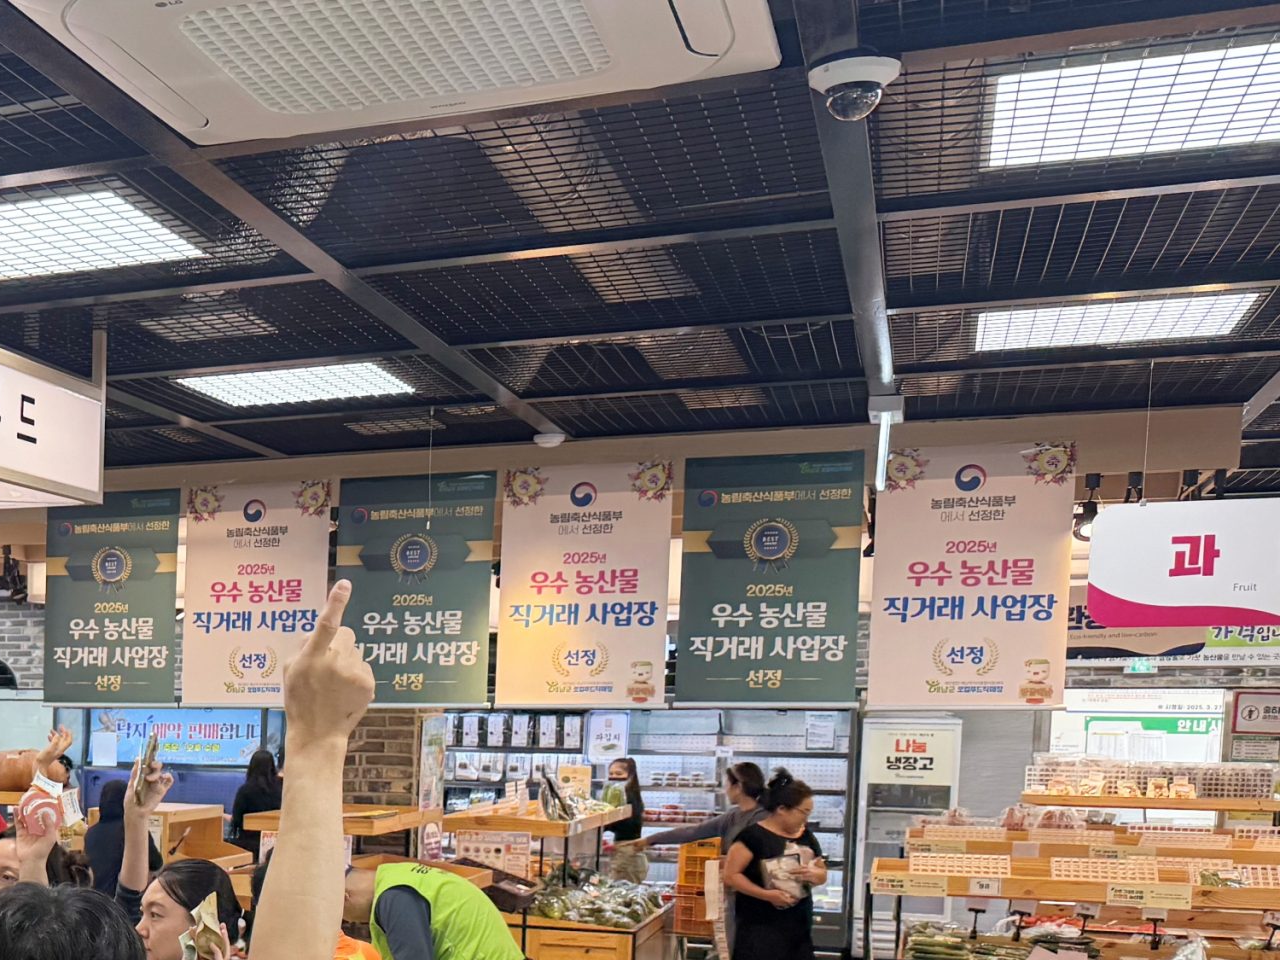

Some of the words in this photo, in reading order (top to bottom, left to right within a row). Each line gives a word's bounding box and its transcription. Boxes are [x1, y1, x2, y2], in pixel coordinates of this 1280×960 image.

[721, 490, 816, 503] 농림축산식품부에서
[819, 488, 852, 500] 선정한
[931, 495, 1016, 509] 농림축산식품부
[455, 505, 483, 517] 선정한
[549, 511, 623, 524] 농림축산식품부
[941, 510, 964, 522] 에서
[968, 509, 1005, 521] 선정한
[146, 520, 170, 531] 선정한
[226, 525, 289, 539] 농림축산식품부
[581, 523, 613, 535] 선정한
[253, 537, 280, 548] 선정한
[946, 541, 997, 554] 2025년
[563, 552, 606, 565] 2025년
[1169, 535, 1220, 577] 과
[237, 563, 275, 576] 2025년
[907, 561, 952, 587] 우수
[960, 559, 1034, 586] 농산물
[530, 572, 568, 594] 우수
[575, 569, 639, 594] 농산물
[1233, 583, 1257, 592] Fruit
[209, 582, 244, 604] 우수
[247, 579, 303, 604] 농산물
[746, 583, 793, 597] 2025년
[94, 602, 128, 614] 2025년
[392, 594, 433, 607] 2025년
[883, 596, 964, 622] 직거래
[971, 594, 1057, 622] 사업장
[192, 610, 252, 633] 직거래
[257, 608, 319, 633] 사업장
[509, 603, 579, 627] 직거래
[588, 601, 658, 627] 사업장
[711, 605, 752, 628] 우수
[759, 602, 827, 627] 농산물
[69, 618, 99, 640] 우수
[104, 617, 154, 640] 농산물
[362, 613, 398, 635] 우수
[403, 610, 462, 635] 농산물
[412, 641, 480, 666] 사업장
[690, 638, 763, 662] 직거래
[773, 635, 848, 661] 사업장
[947, 646, 984, 664] 선정
[53, 647, 107, 669] 직거래
[112, 646, 169, 669] 사업장
[239, 653, 266, 669] 선정
[564, 649, 597, 666] 선정
[94, 674, 121, 691] 선정
[392, 674, 423, 691] 선정
[745, 670, 782, 688] 선정
[895, 739, 927, 752] 나눔
[887, 757, 934, 770] 냉장고
